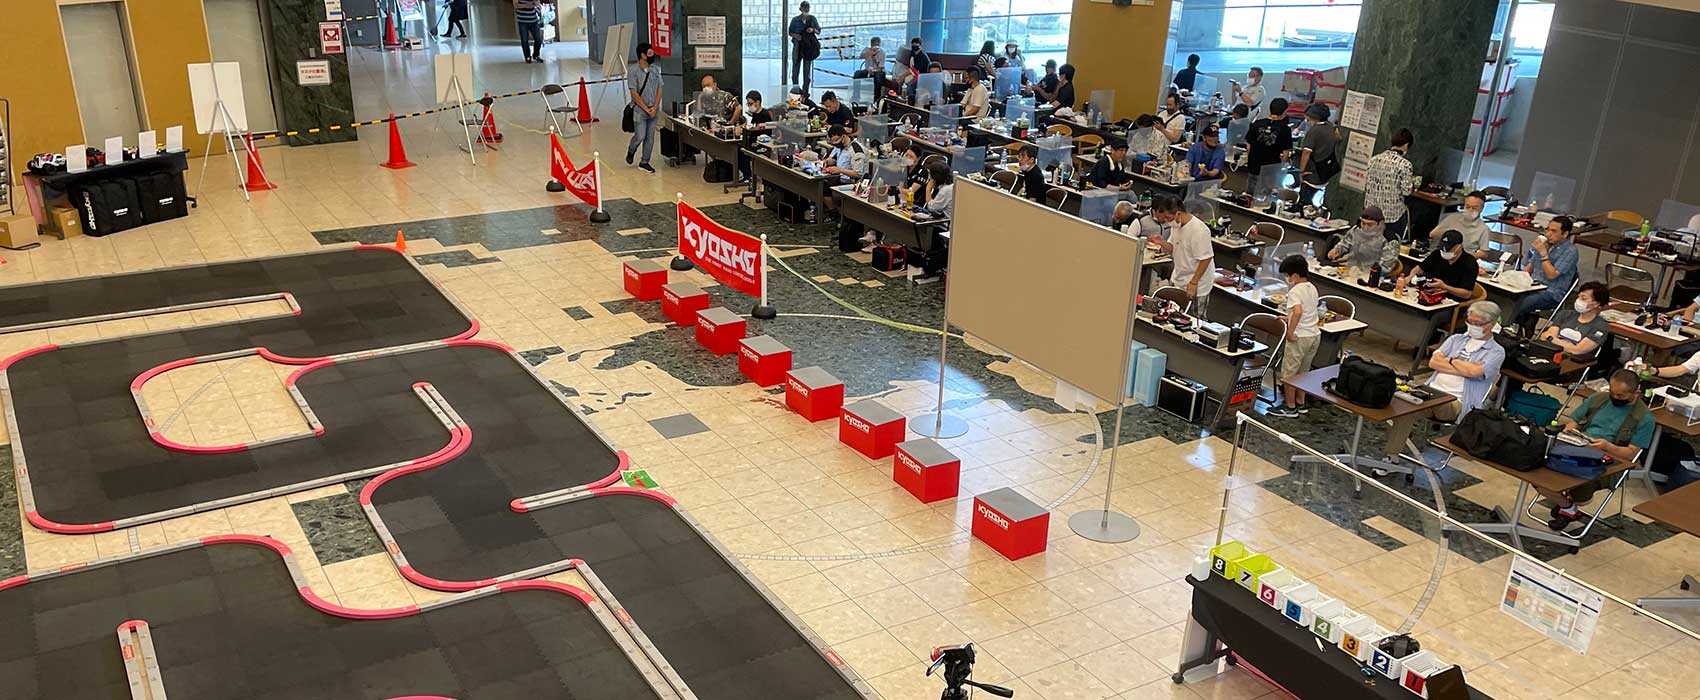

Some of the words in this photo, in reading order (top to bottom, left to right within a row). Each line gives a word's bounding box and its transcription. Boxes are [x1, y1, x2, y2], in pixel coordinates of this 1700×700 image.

[681, 215, 757, 276] KYOSHO
[788, 378, 809, 397] KYOSHO
[843, 414, 870, 433] KYOSHO
[897, 451, 922, 474] KYOSHO
[977, 504, 1009, 529] KYOSHO
[1214, 558, 1224, 570] 8
[1241, 571, 1252, 582] 7
[1263, 589, 1273, 600] 6
[1289, 604, 1298, 615] 5
[1316, 621, 1328, 633] 4
[1346, 638, 1356, 650] 3
[1375, 655, 1387, 669] 2
[1410, 672, 1418, 687] 1
